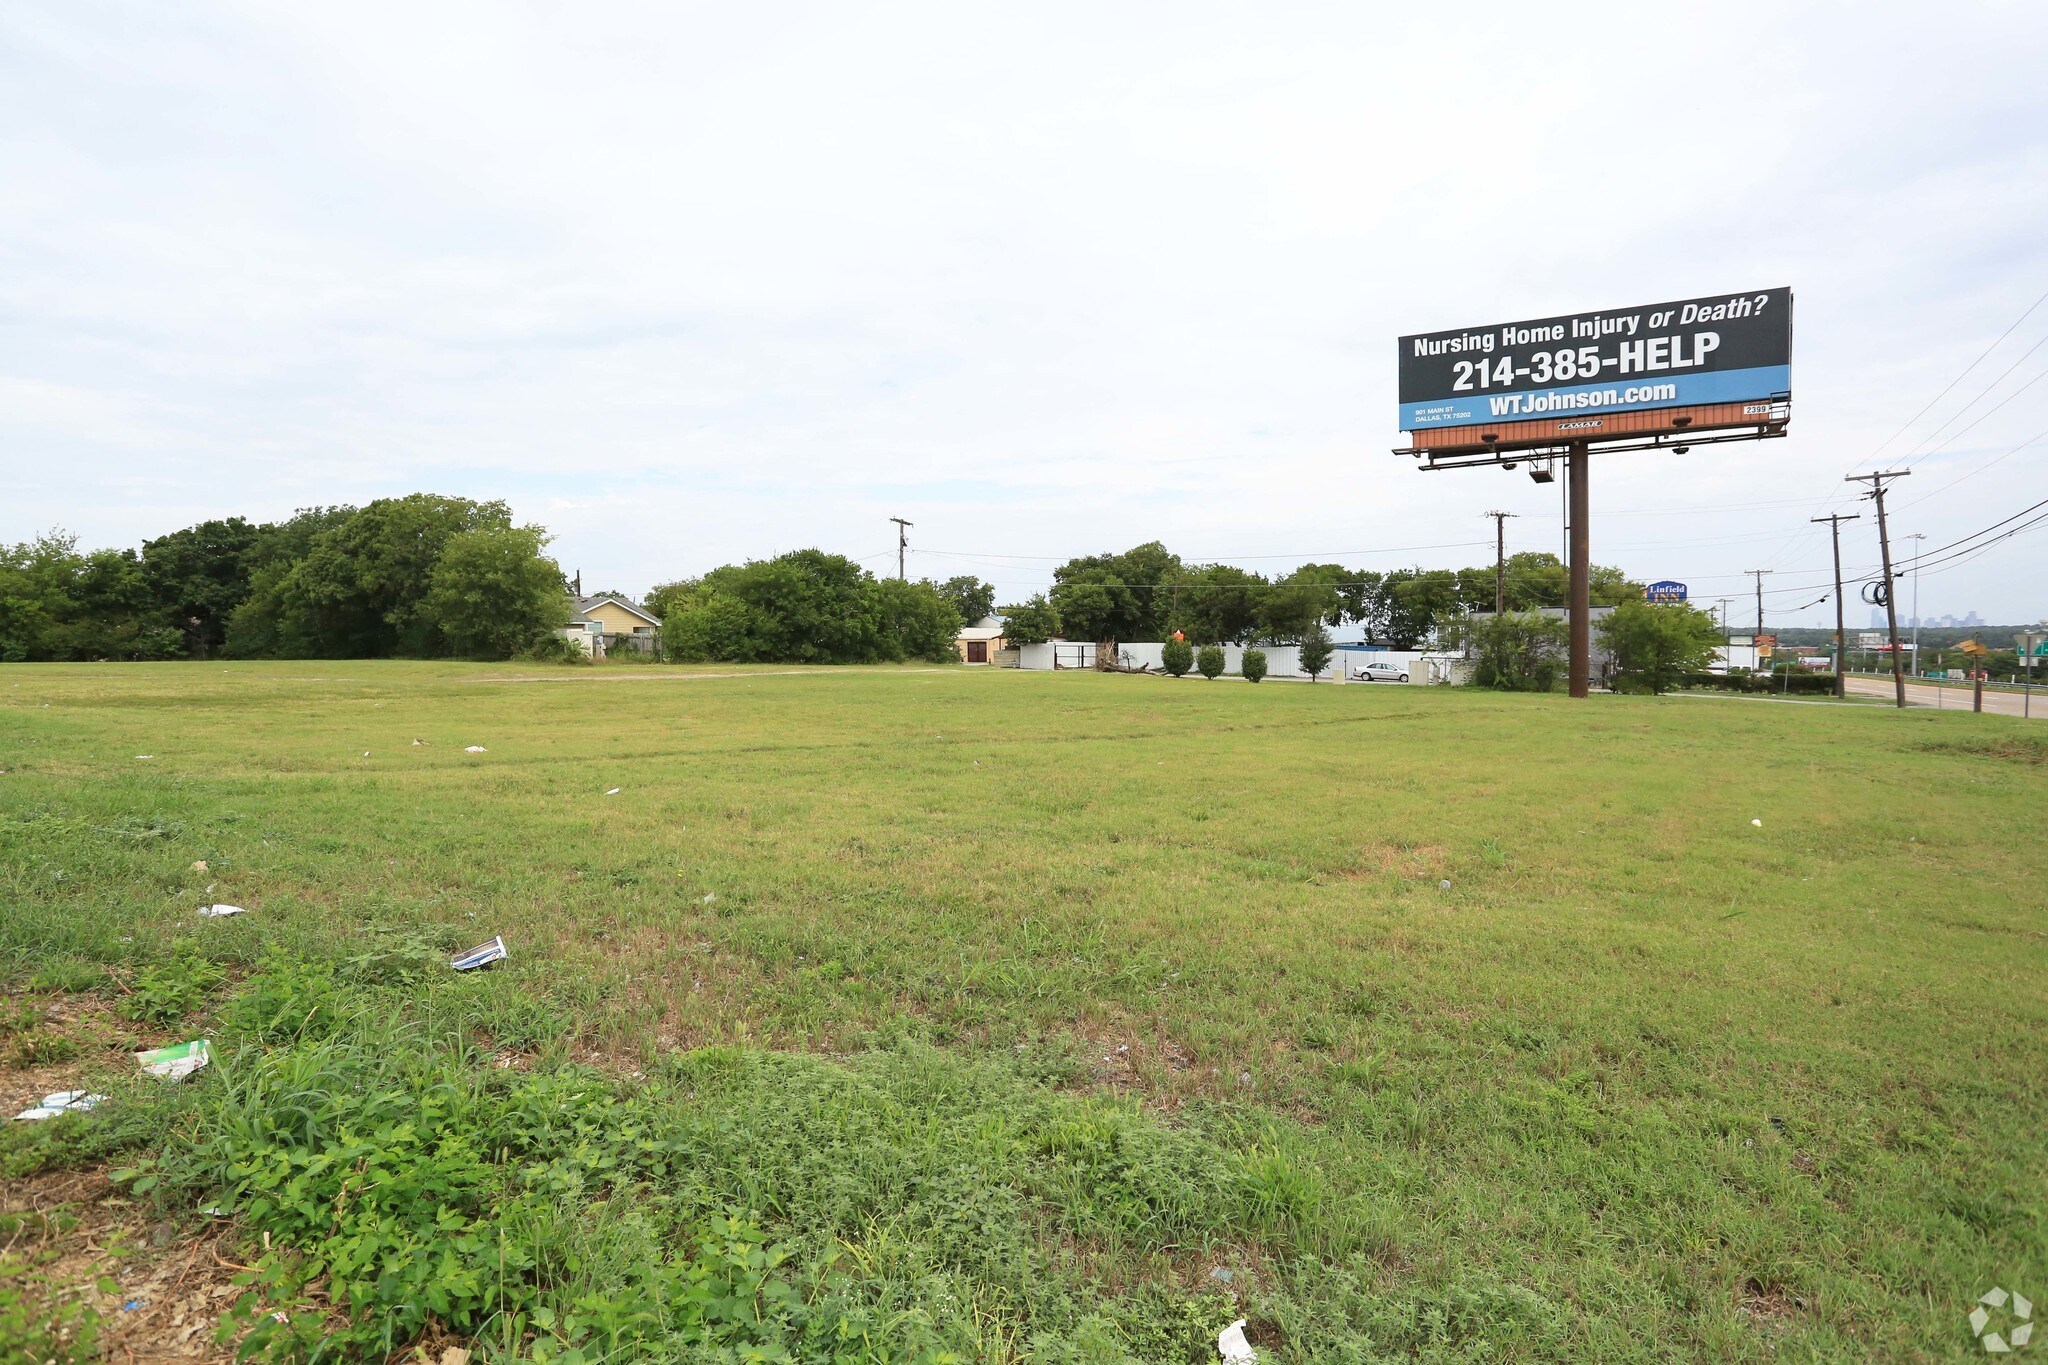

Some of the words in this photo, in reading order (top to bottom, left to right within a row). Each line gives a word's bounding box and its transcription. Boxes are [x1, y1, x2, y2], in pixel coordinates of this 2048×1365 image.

[1414, 333, 1495, 357] Nursing
[1502, 325, 1565, 346] Home
[1572, 315, 1640, 340] Injury
[1649, 310, 1675, 329] or
[1680, 295, 1769, 325] Death?
[1453, 332, 1720, 391] 214-385-HELP
[1490, 383, 1676, 416] WTJohnson.com
[1747, 405, 1766, 413] 2399
[1452, 411, 1471, 419] 75202
[1561, 421, 1600, 429] LAMAR
[1650, 585, 1685, 593] Linfield
[1654, 593, 1680, 602] INN
